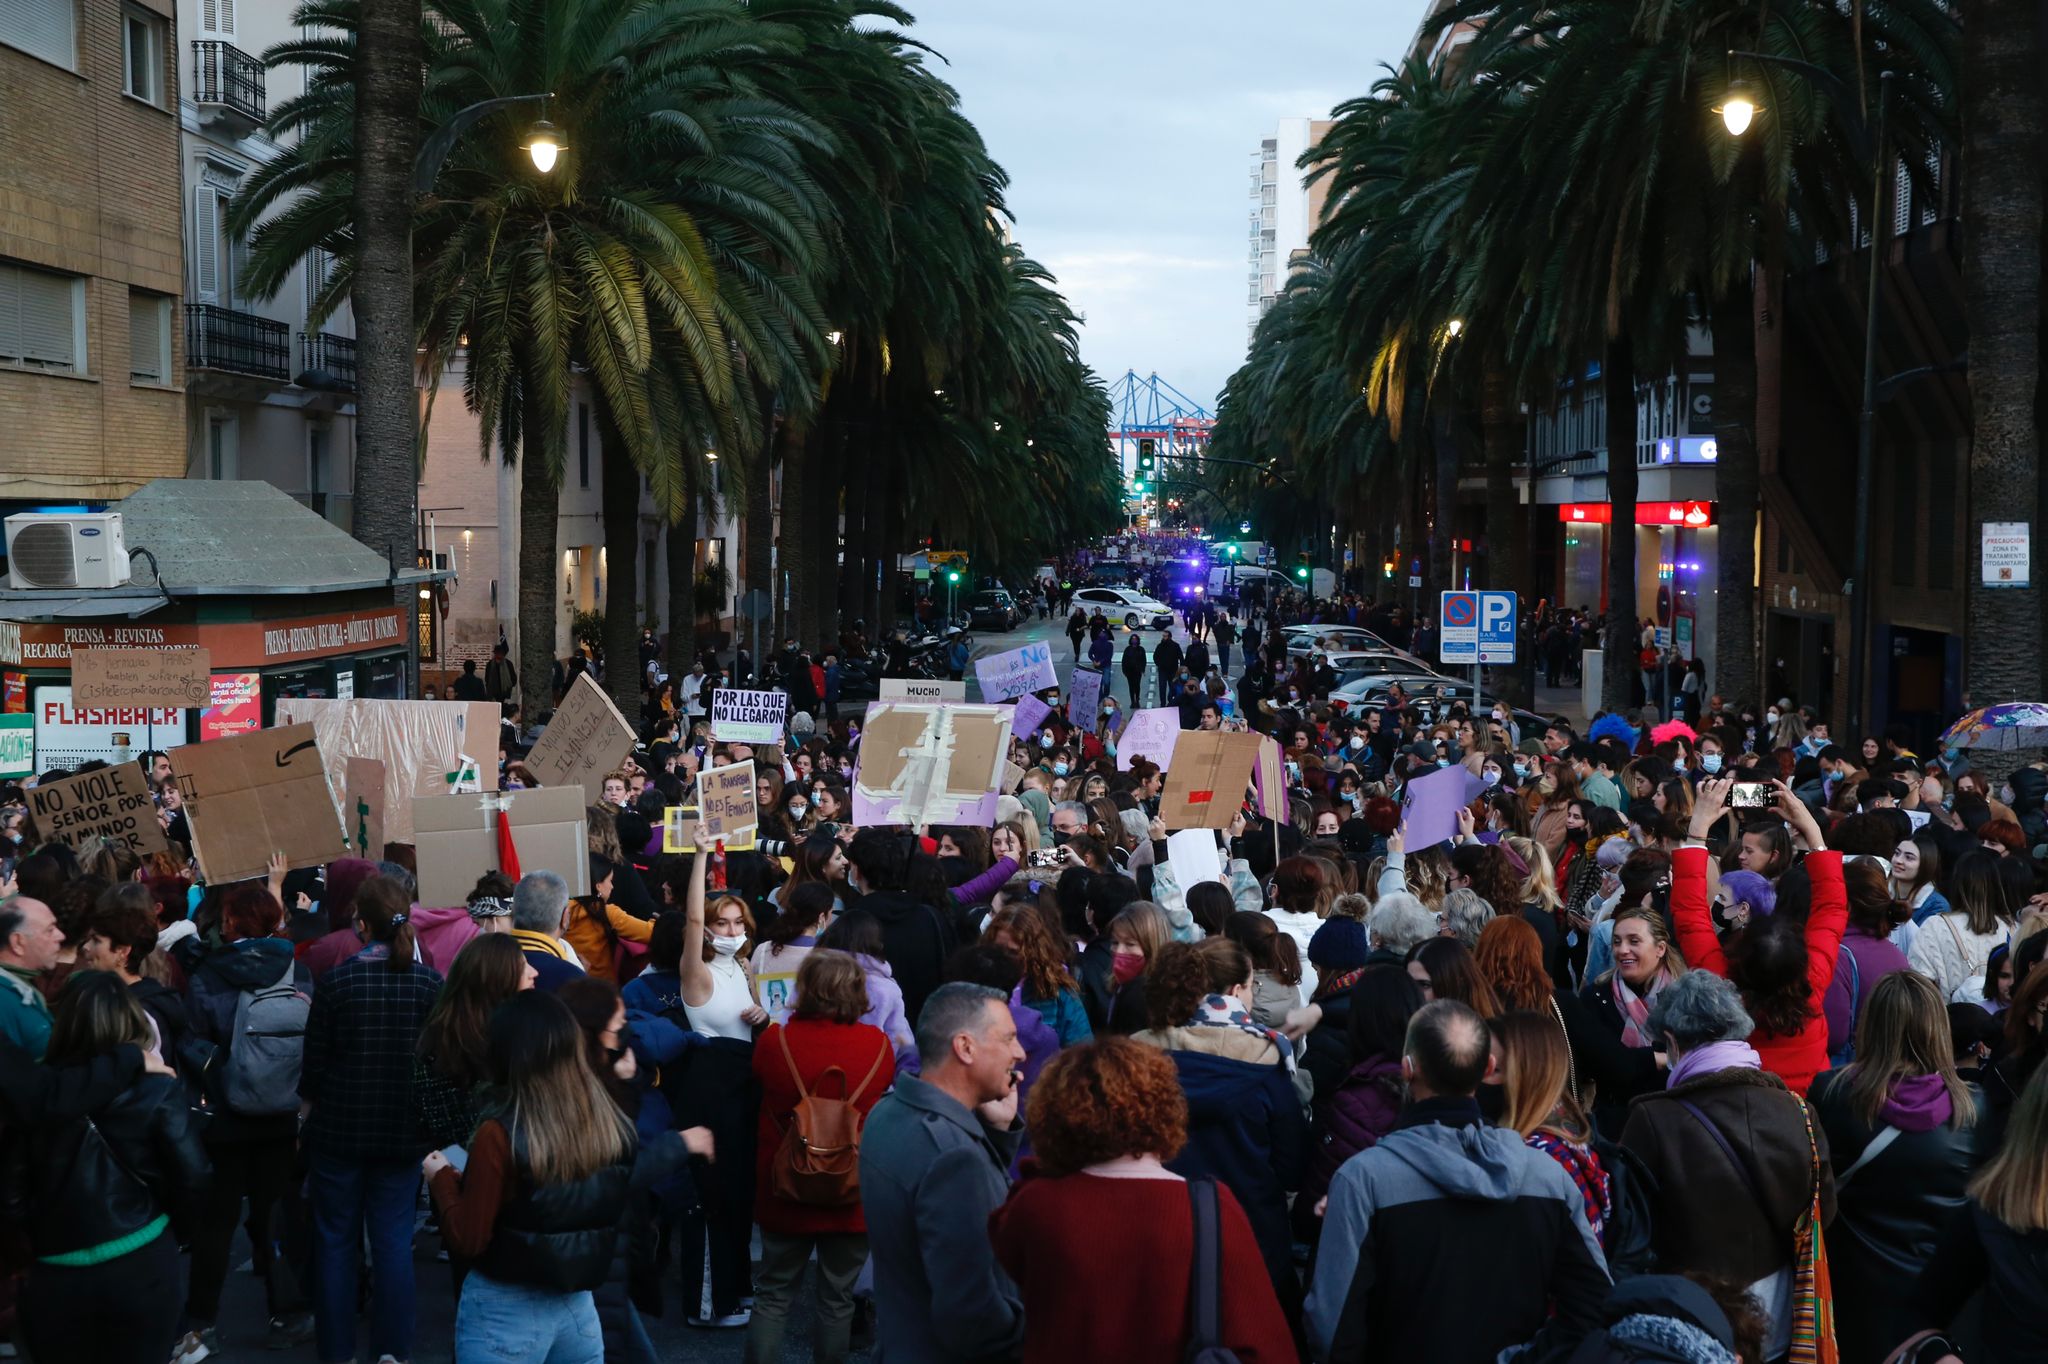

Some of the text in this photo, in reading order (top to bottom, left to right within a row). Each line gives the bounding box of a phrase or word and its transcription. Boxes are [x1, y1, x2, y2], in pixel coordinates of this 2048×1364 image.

[1482, 595, 1512, 632] P
[64, 628, 164, 643] PRENSA REVISTAS
[265, 629, 289, 656] PRENSA
[290, 626, 316, 652] REVISTAS
[318, 623, 344, 648] RECARGA
[375, 614, 399, 640] BONOBUS
[24, 643, 72, 659] RECARGA
[1020, 646, 1049, 668] NO
[714, 690, 786, 709] POR LAS QUE
[907, 686, 941, 697] MUCHO
[1674, 696, 1682, 707] P
[44, 702, 178, 725] FLASHBACK
[713, 706, 784, 724] NO LLEGARON
[529, 753, 546, 768] EL
[541, 711, 571, 752] MUNDO
[554, 711, 600, 774] FEMINISTA
[581, 753, 597, 774] NO
[33, 770, 127, 816] NO VIOLE
[701, 775, 714, 795] LA
[119, 793, 149, 812] POR
[705, 795, 755, 818] NO ES FEMINISTA
[77, 816, 137, 844] MUNDO
